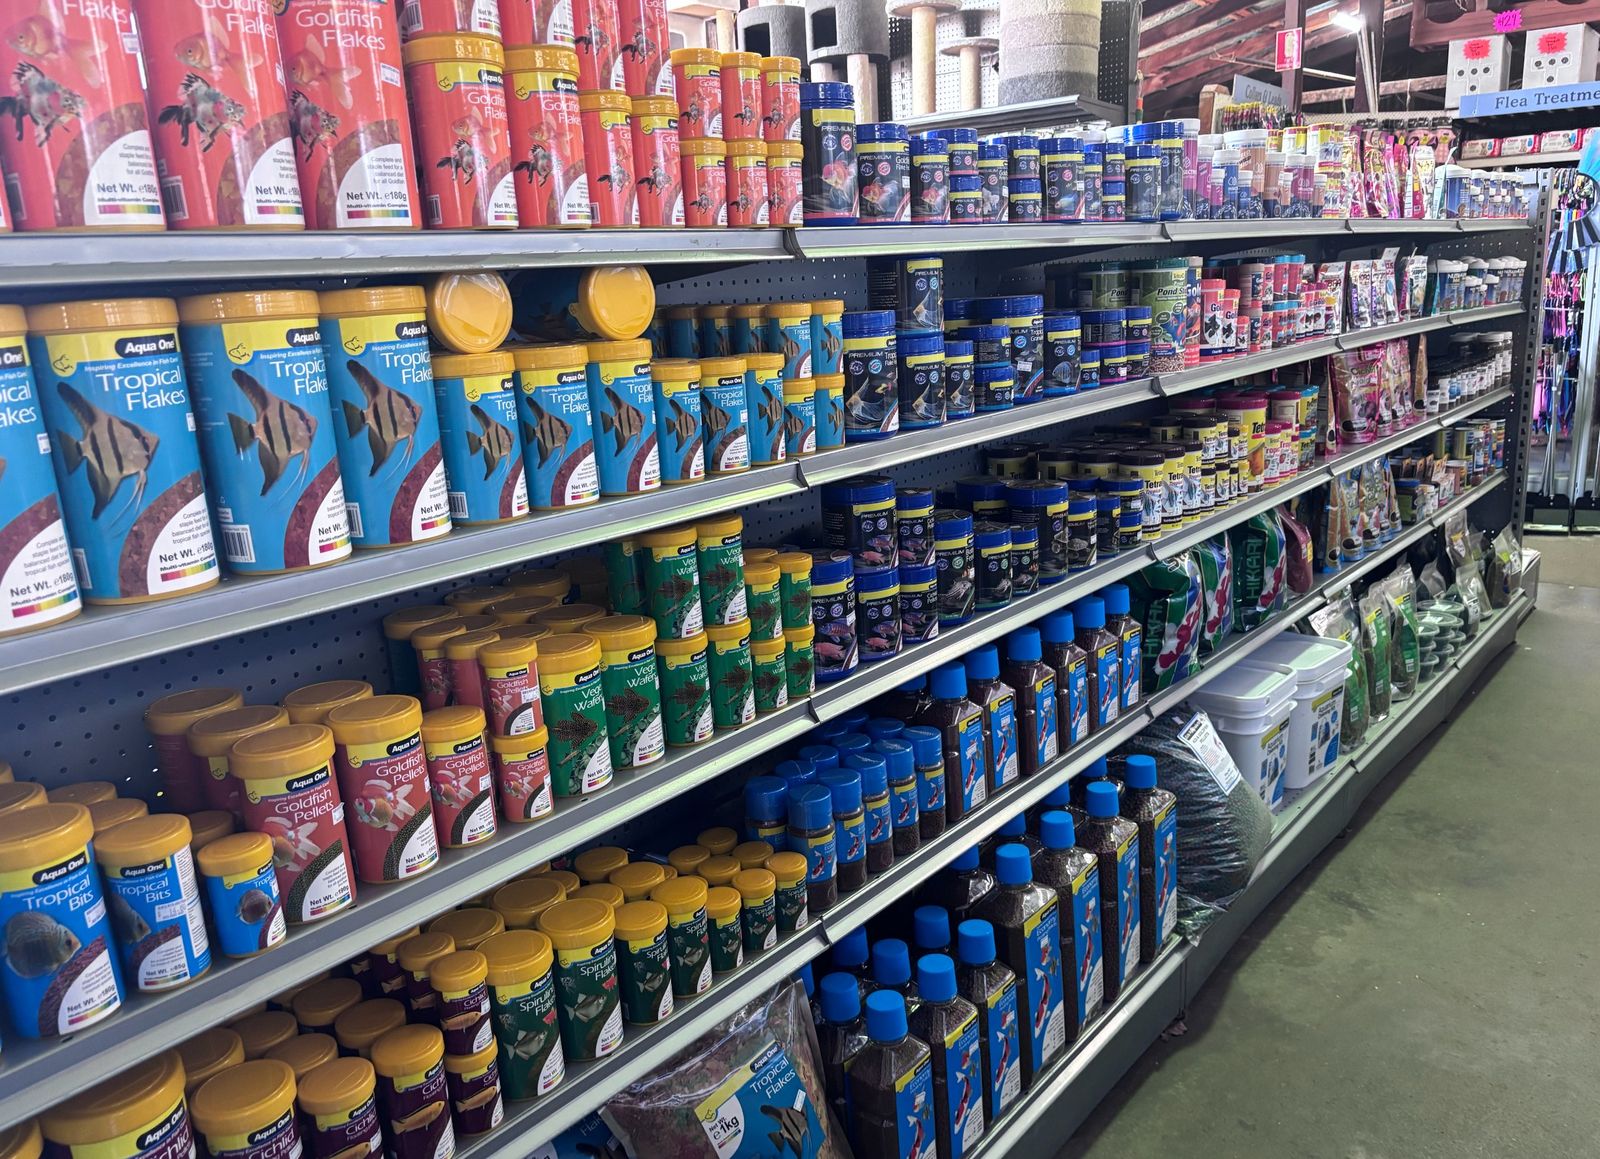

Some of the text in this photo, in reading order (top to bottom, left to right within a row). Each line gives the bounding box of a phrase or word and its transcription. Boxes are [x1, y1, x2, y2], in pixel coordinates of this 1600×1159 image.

[296, 9, 383, 29] Goldfish
[323, 29, 386, 50] Flakes
[482, 72, 497, 82] Aqua
[1495, 90, 1600, 109] Flea Treatme
[97, 183, 118, 193] Net
[119, 183, 137, 193] Wt.
[255, 185, 287, 195] Net Wt.
[346, 191, 364, 201] Net
[366, 191, 382, 200] Wt.
[1157, 288, 1177, 296] Pond
[292, 332, 314, 344] Aqua
[402, 326, 420, 337] Aqua
[125, 338, 175, 356] Aqua One
[3, 352, 22, 364] One
[84, 363, 116, 372] Inspiring
[117, 360, 151, 369] Excellence
[95, 366, 182, 392] Tropical
[561, 374, 576, 383] Aqua
[126, 389, 186, 411] Flakes
[712, 390, 743, 401] Tropical
[720, 399, 744, 407] Flakes
[421, 504, 444, 515] Net Wt.
[318, 522, 343, 536] Net Wt.
[159, 552, 178, 564] Net
[179, 548, 196, 560] Wt.
[1246, 538, 1262, 600] HIKARI
[10, 586, 31, 598] Net
[32, 580, 52, 594] Wt.
[632, 652, 646, 661] Aqua
[496, 678, 528, 689] Goldfish
[579, 672, 593, 682] Aqua
[391, 736, 420, 754] Aqua One
[457, 739, 481, 752] Aqua One
[376, 754, 424, 777] Goldfish
[445, 751, 484, 769] Goldfish
[517, 758, 546, 771] Goldfish
[393, 765, 425, 786] Pellets
[458, 761, 486, 776] Pellets
[292, 770, 328, 790] Aqua One
[275, 787, 332, 815] Goldfish
[294, 800, 334, 824] Pellets
[405, 856, 417, 864] Net
[40, 856, 85, 883] Aqua One
[124, 862, 164, 877] Aqua One
[22, 874, 91, 911] Tropical
[116, 878, 169, 898] Tropical
[69, 890, 94, 912] Bits
[145, 888, 172, 904] Bits
[310, 898, 322, 907] Net
[323, 893, 334, 903] Wt.
[595, 945, 607, 955] Aqua
[145, 969, 157, 977] Net
[534, 979, 546, 989] Aqua
[67, 1003, 82, 1015] Net
[82, 995, 97, 1008] Wt.
[754, 1045, 778, 1070] Aqua One
[749, 1055, 790, 1093] Tropical
[765, 1069, 796, 1099] Flakes
[352, 1108, 367, 1118] Aqua
[144, 1107, 185, 1146] Aqua One
[254, 1115, 291, 1141] Aqua One
[709, 1122, 719, 1132] Net
